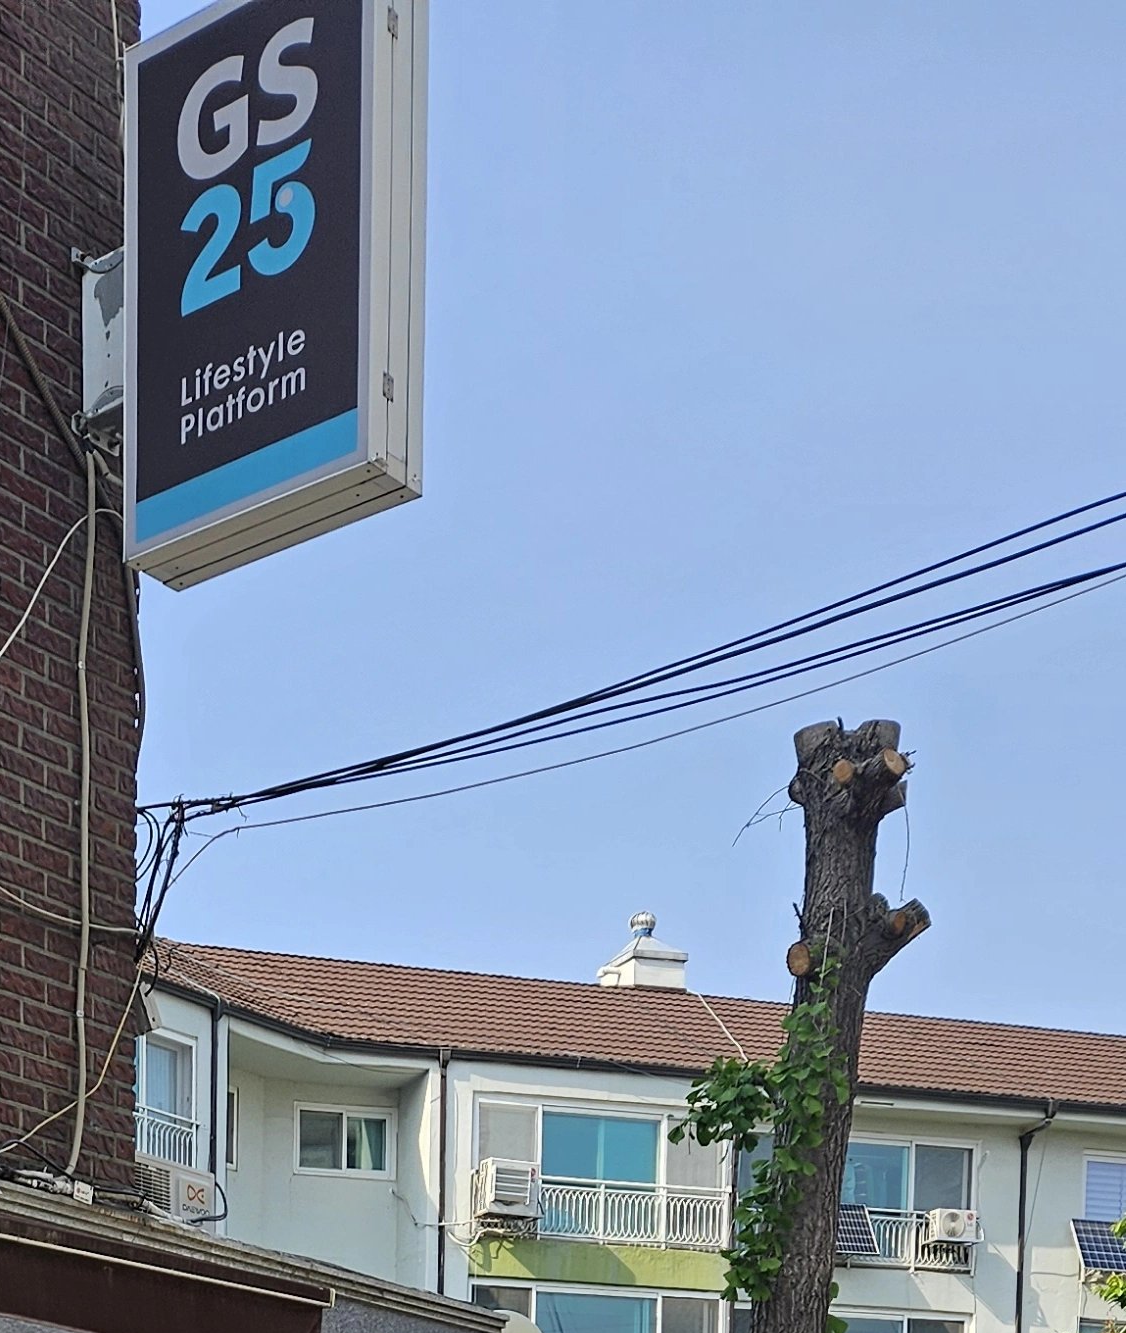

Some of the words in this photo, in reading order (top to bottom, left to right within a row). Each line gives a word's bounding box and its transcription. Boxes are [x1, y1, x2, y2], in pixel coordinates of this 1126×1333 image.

[177, 17, 318, 181] GS
[180, 137, 316, 318] 25
[180, 328, 306, 407] Lifestyle
[180, 364, 306, 445] Platform
